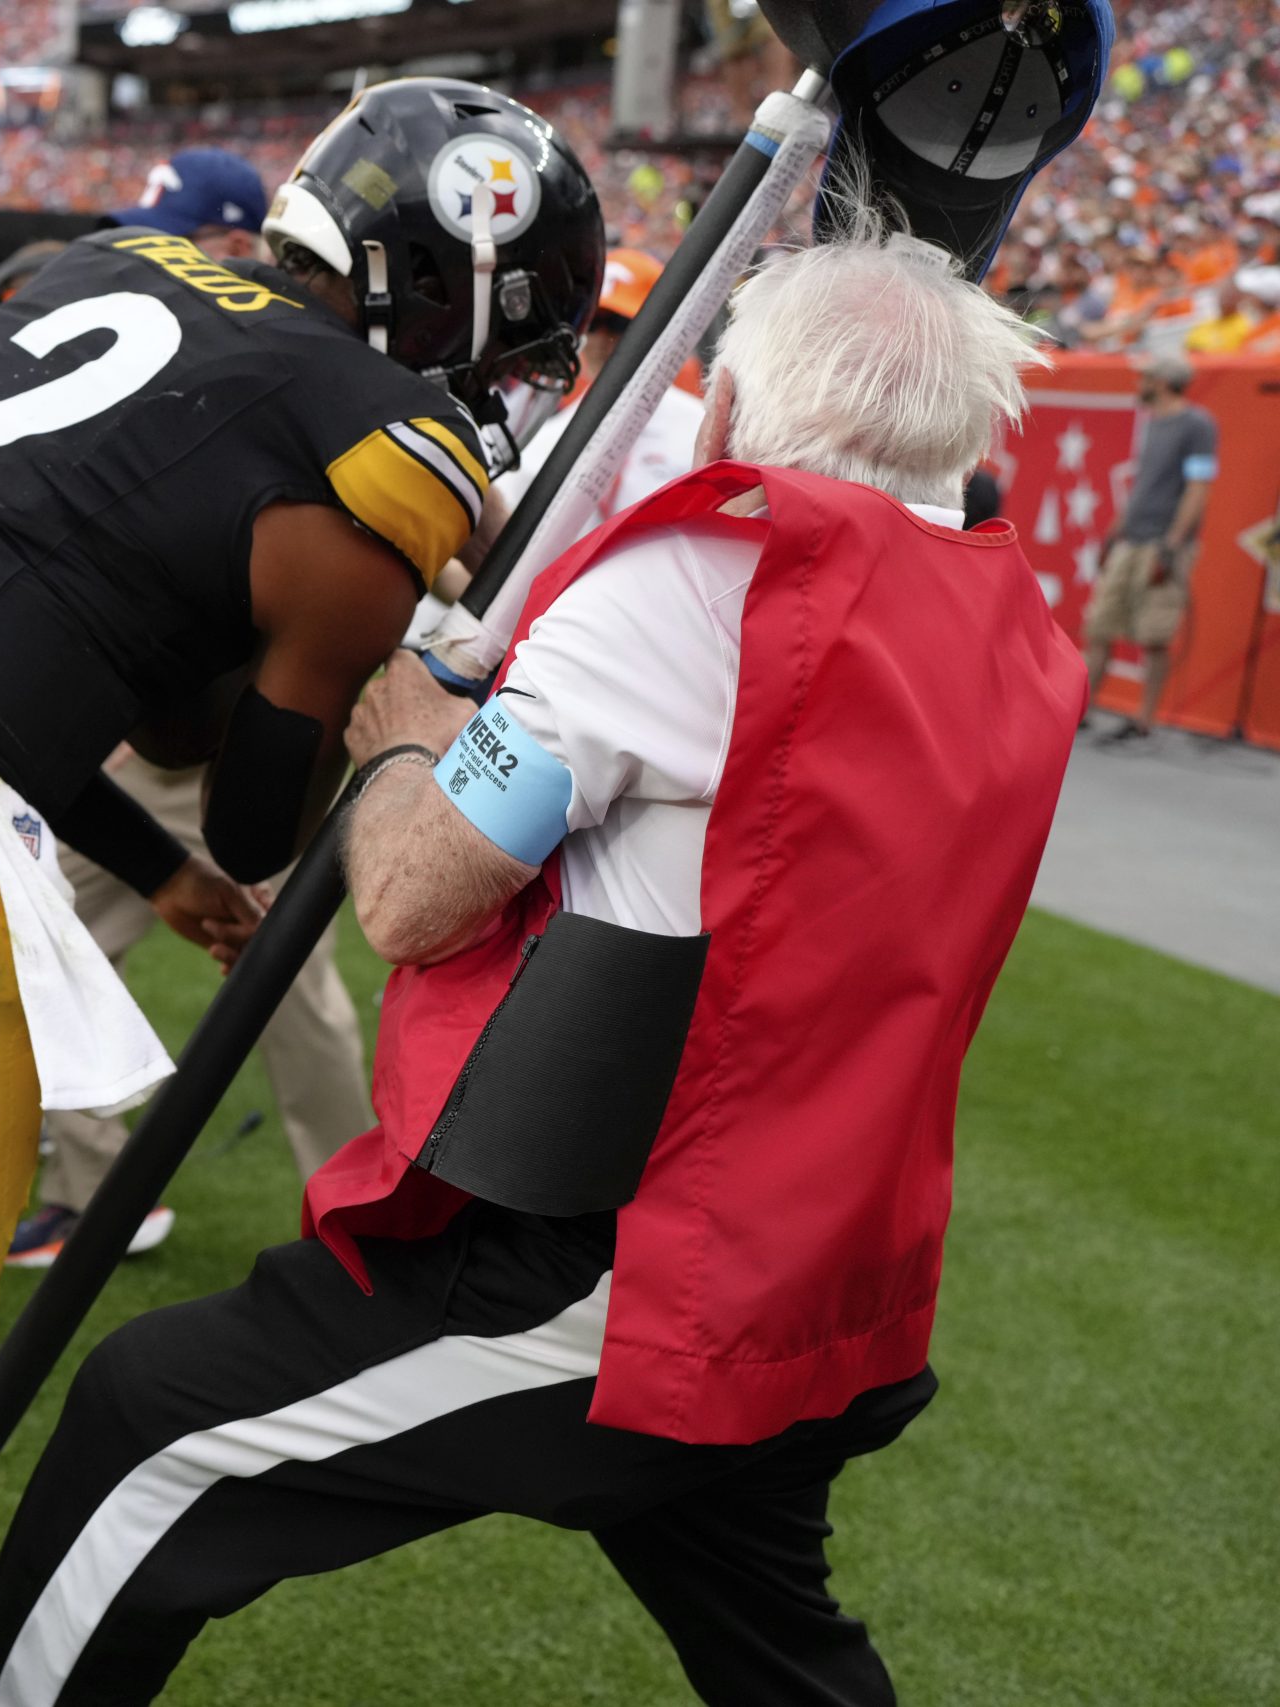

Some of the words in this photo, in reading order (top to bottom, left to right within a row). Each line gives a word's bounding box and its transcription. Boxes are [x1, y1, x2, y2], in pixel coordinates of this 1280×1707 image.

[491, 711, 509, 733] DEN
[467, 712, 507, 766] WEEK
[498, 753, 518, 778] 2
[468, 748, 483, 767] Field
[481, 764, 508, 792] Access
